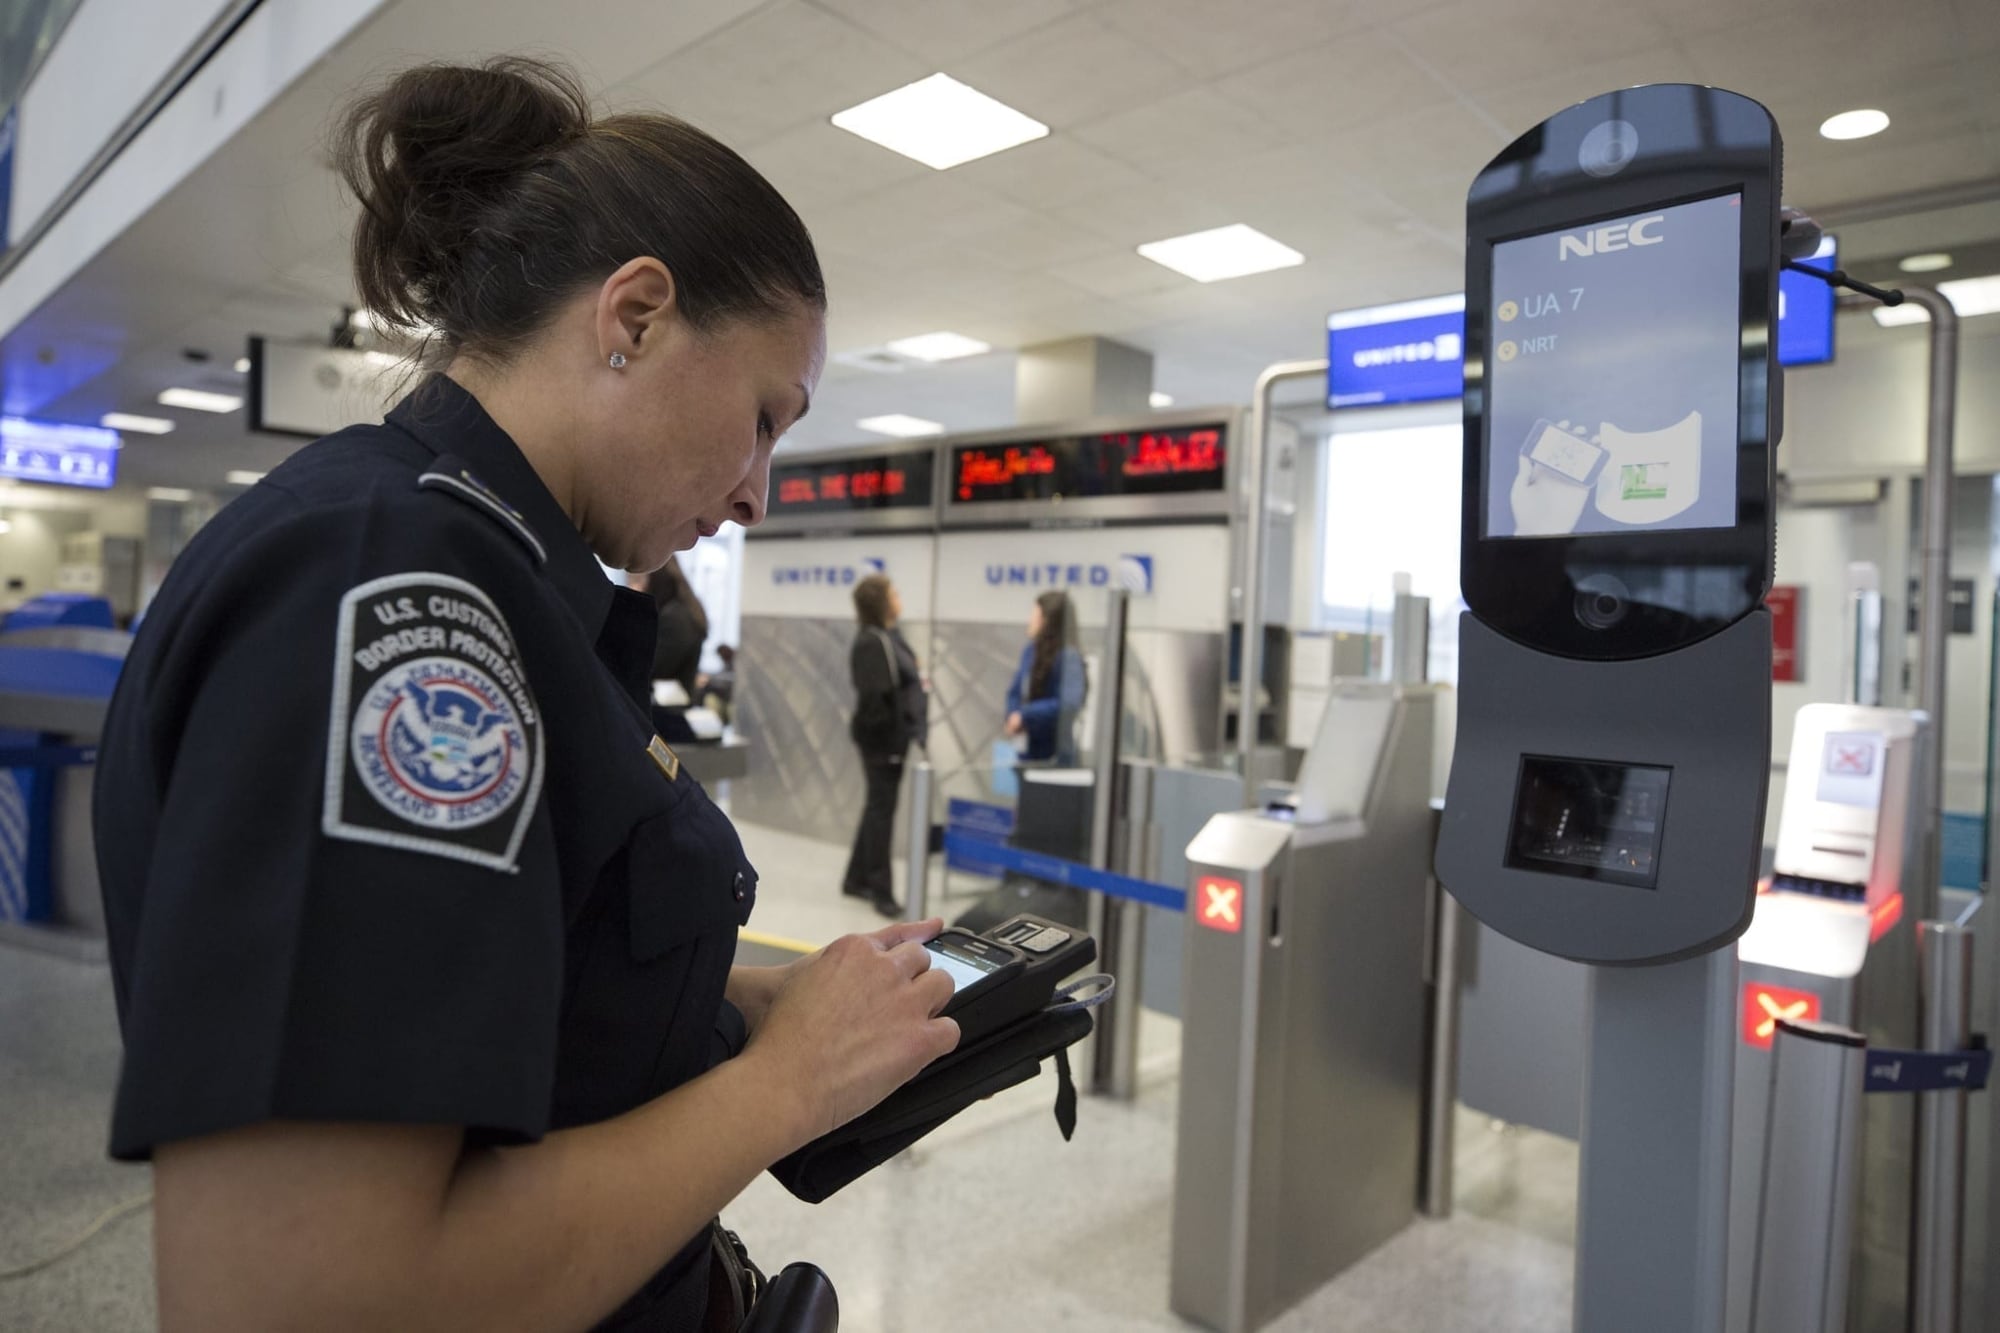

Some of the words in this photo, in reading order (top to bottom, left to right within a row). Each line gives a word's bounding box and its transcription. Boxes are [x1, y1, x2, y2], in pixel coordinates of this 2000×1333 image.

[1559, 215, 1664, 261] NEC
[1523, 293, 1561, 319] UA
[1569, 287, 1585, 311] 7
[1521, 335, 1558, 355] NRT
[772, 567, 856, 586] UNITED
[986, 564, 1109, 587] UNITED
[373, 597, 422, 625] U.S.
[428, 595, 511, 657] CUSTOMS
[354, 626, 447, 672] BORDER
[450, 629, 536, 725] PROTECTION
[360, 735, 438, 820] HOMELAND
